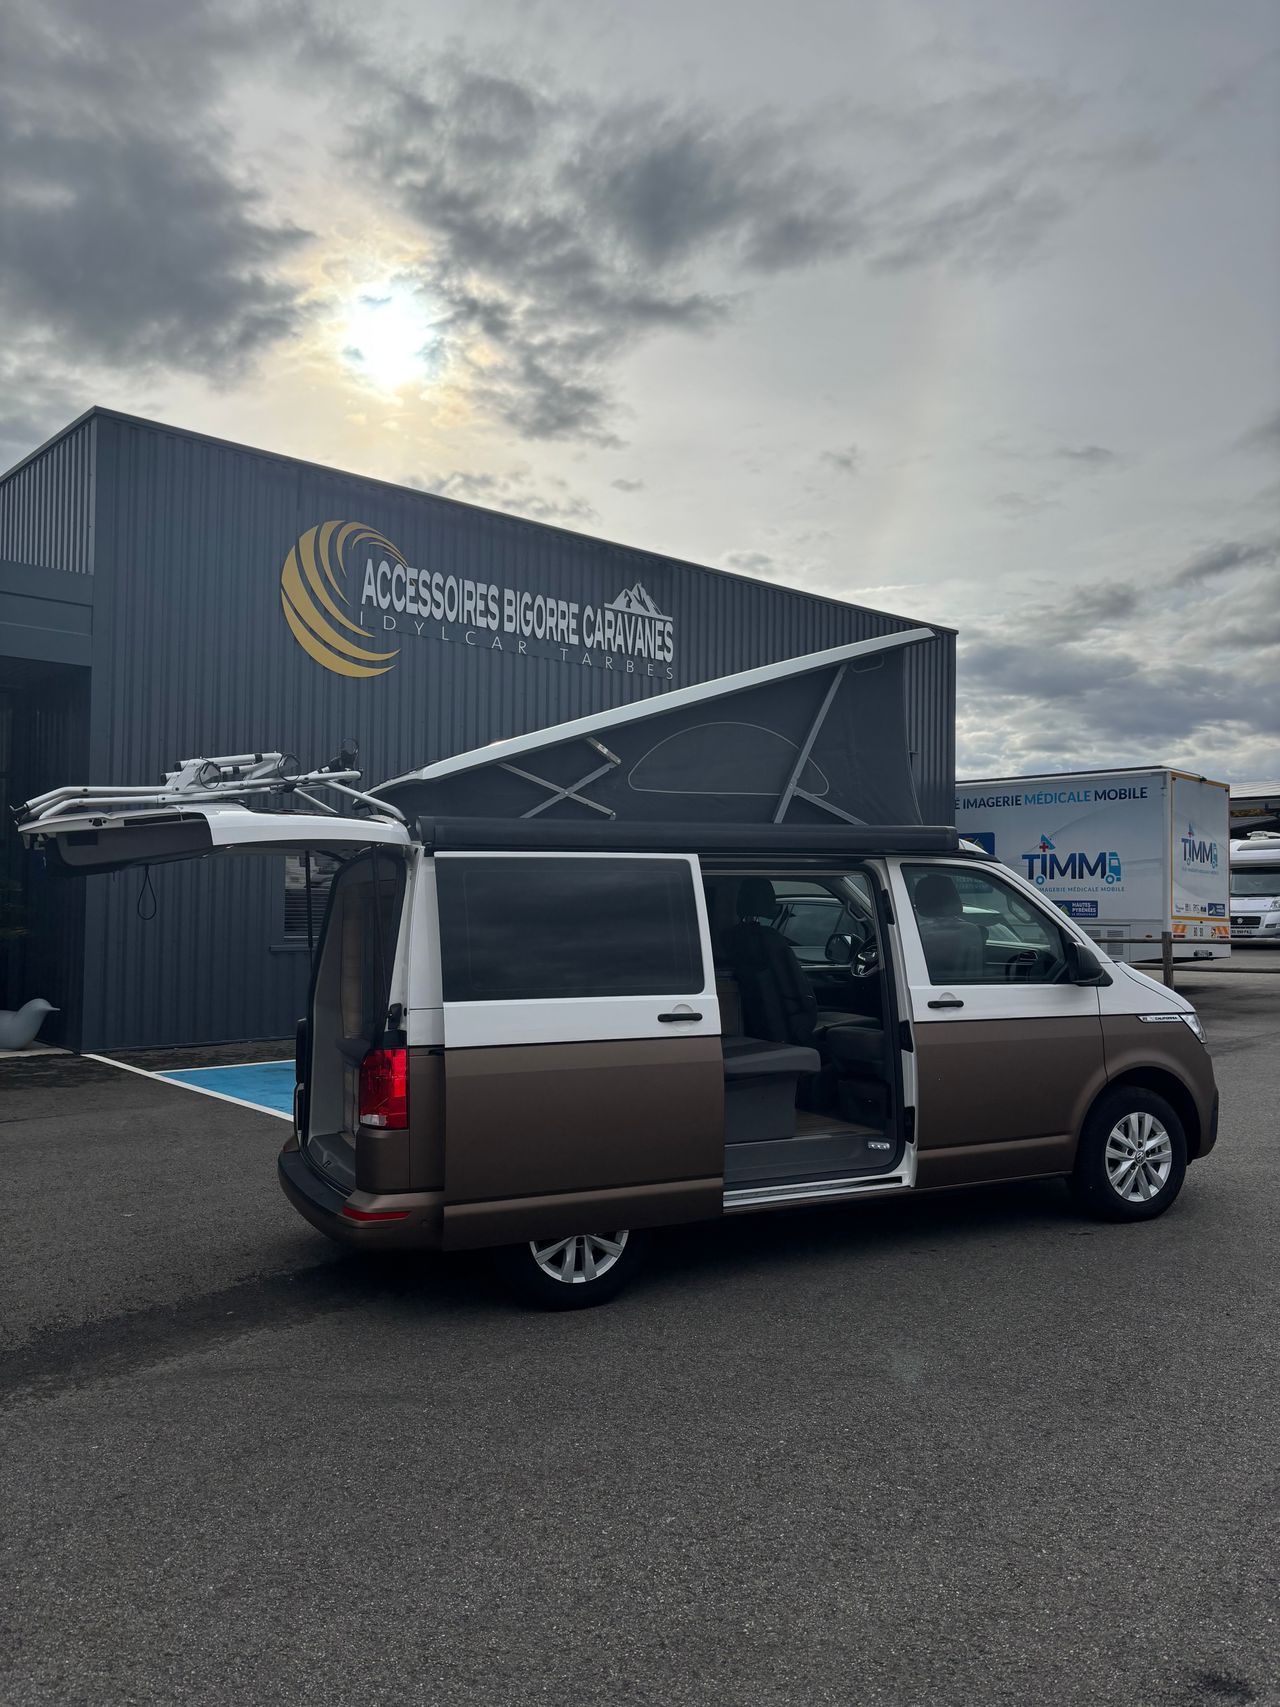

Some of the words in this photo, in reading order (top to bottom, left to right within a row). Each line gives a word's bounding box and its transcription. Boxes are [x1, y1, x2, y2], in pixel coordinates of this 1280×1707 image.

[361, 558, 500, 631] ACCESSOIRES
[503, 588, 579, 645] BIGORRE
[583, 605, 674, 663] CARAVANES
[360, 610, 527, 655] IDYLCAR
[560, 647, 674, 680] TARBES
[962, 794, 1022, 810] IMAGERIE
[1024, 789, 1092, 806] MÉDICALE
[1094, 786, 1148, 802] MOBILE
[1022, 852, 1107, 880] TIMM
[1100, 885, 1125, 893] MOBILE
